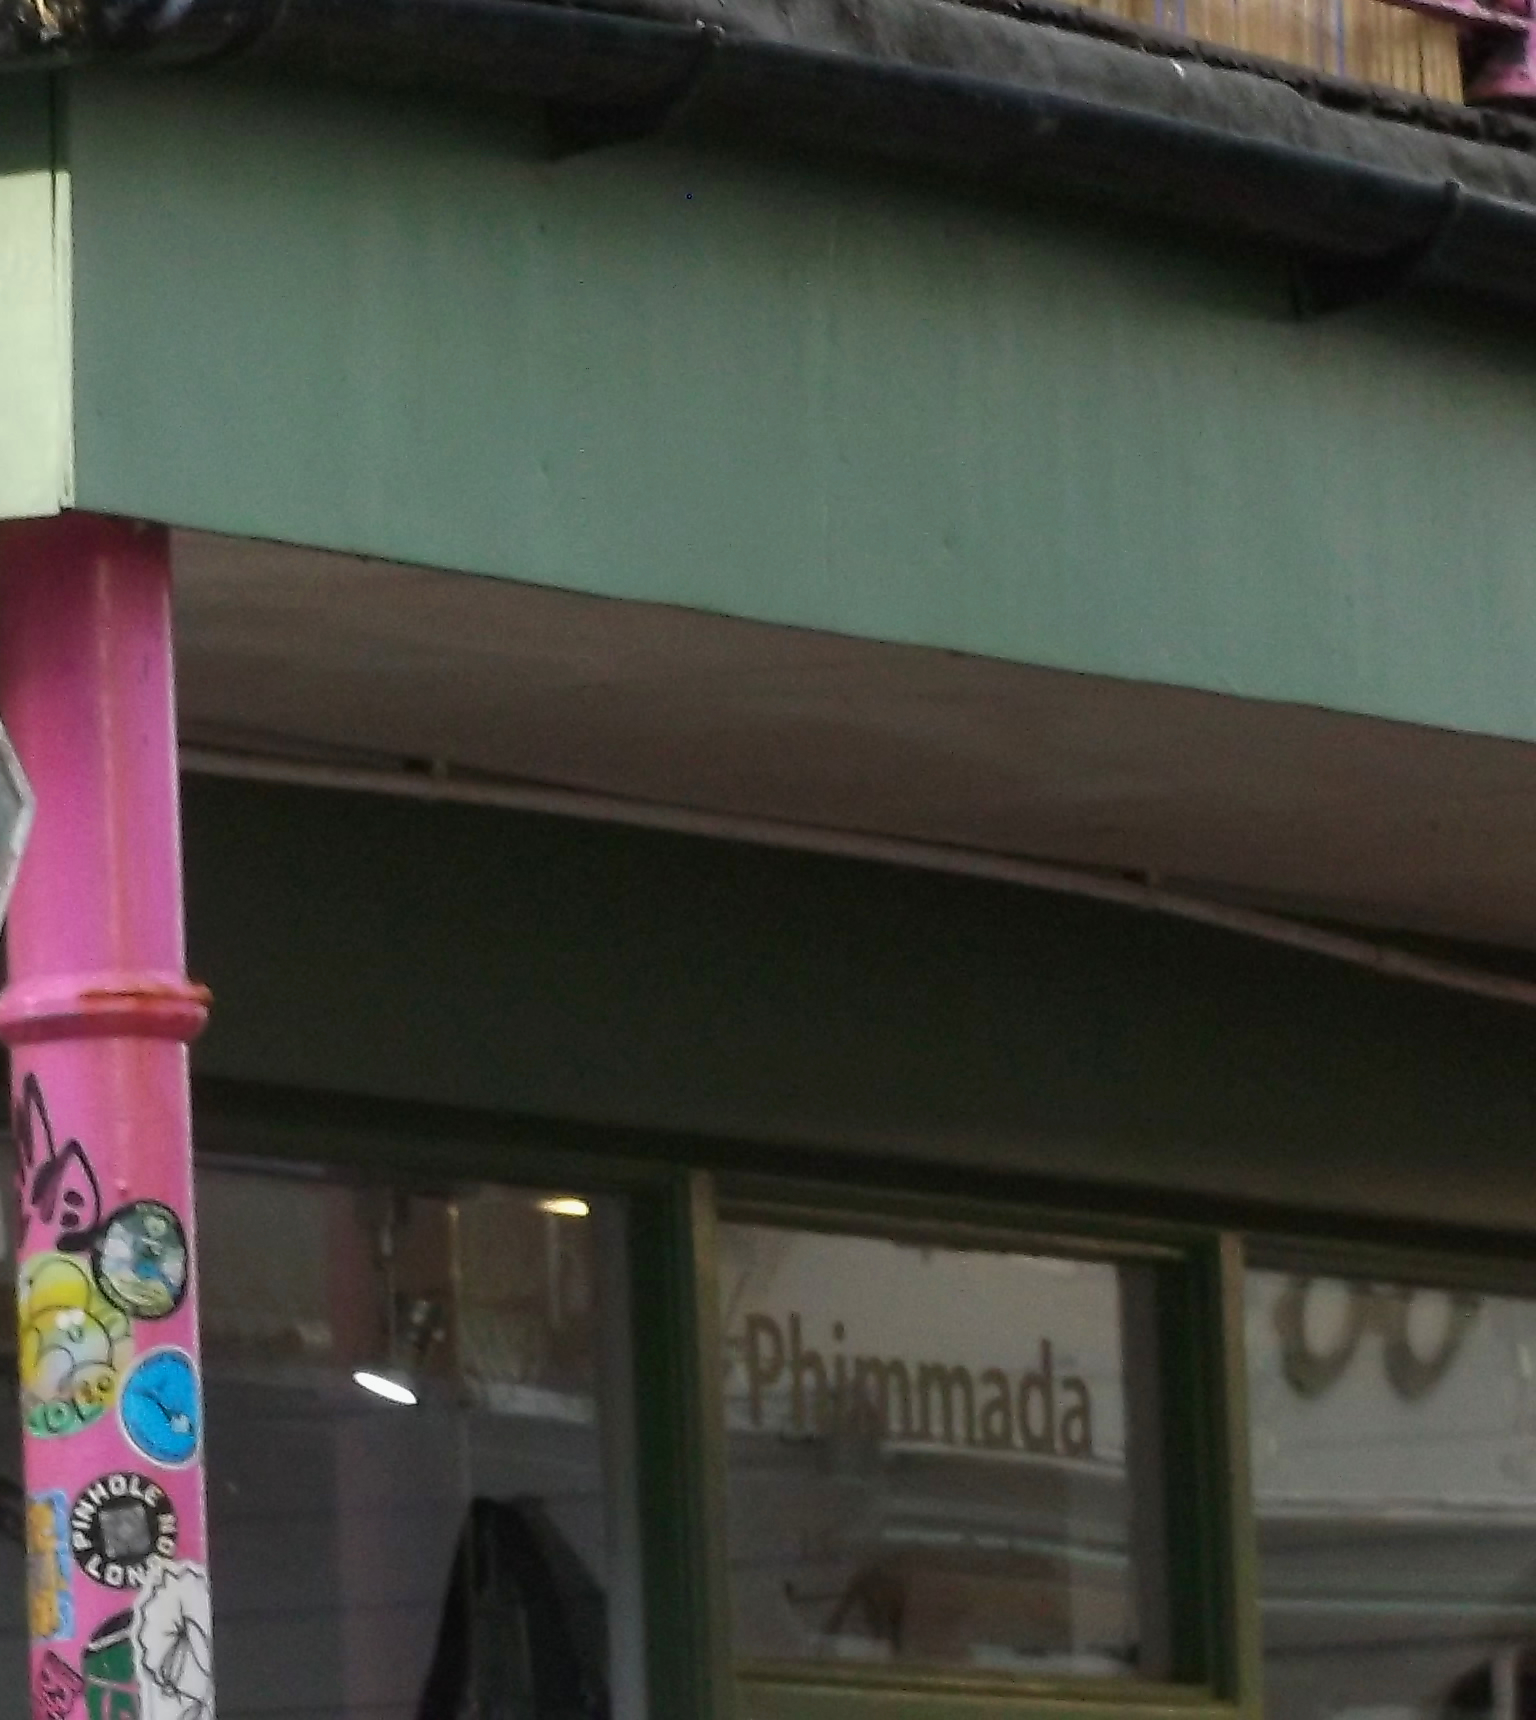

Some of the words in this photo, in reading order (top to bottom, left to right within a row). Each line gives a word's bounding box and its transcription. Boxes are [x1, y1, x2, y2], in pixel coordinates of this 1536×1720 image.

[744, 1311, 1094, 1458] Phimmada
[71, 1473, 165, 1551] PINHOLE
[85, 1512, 177, 1589] LONON
